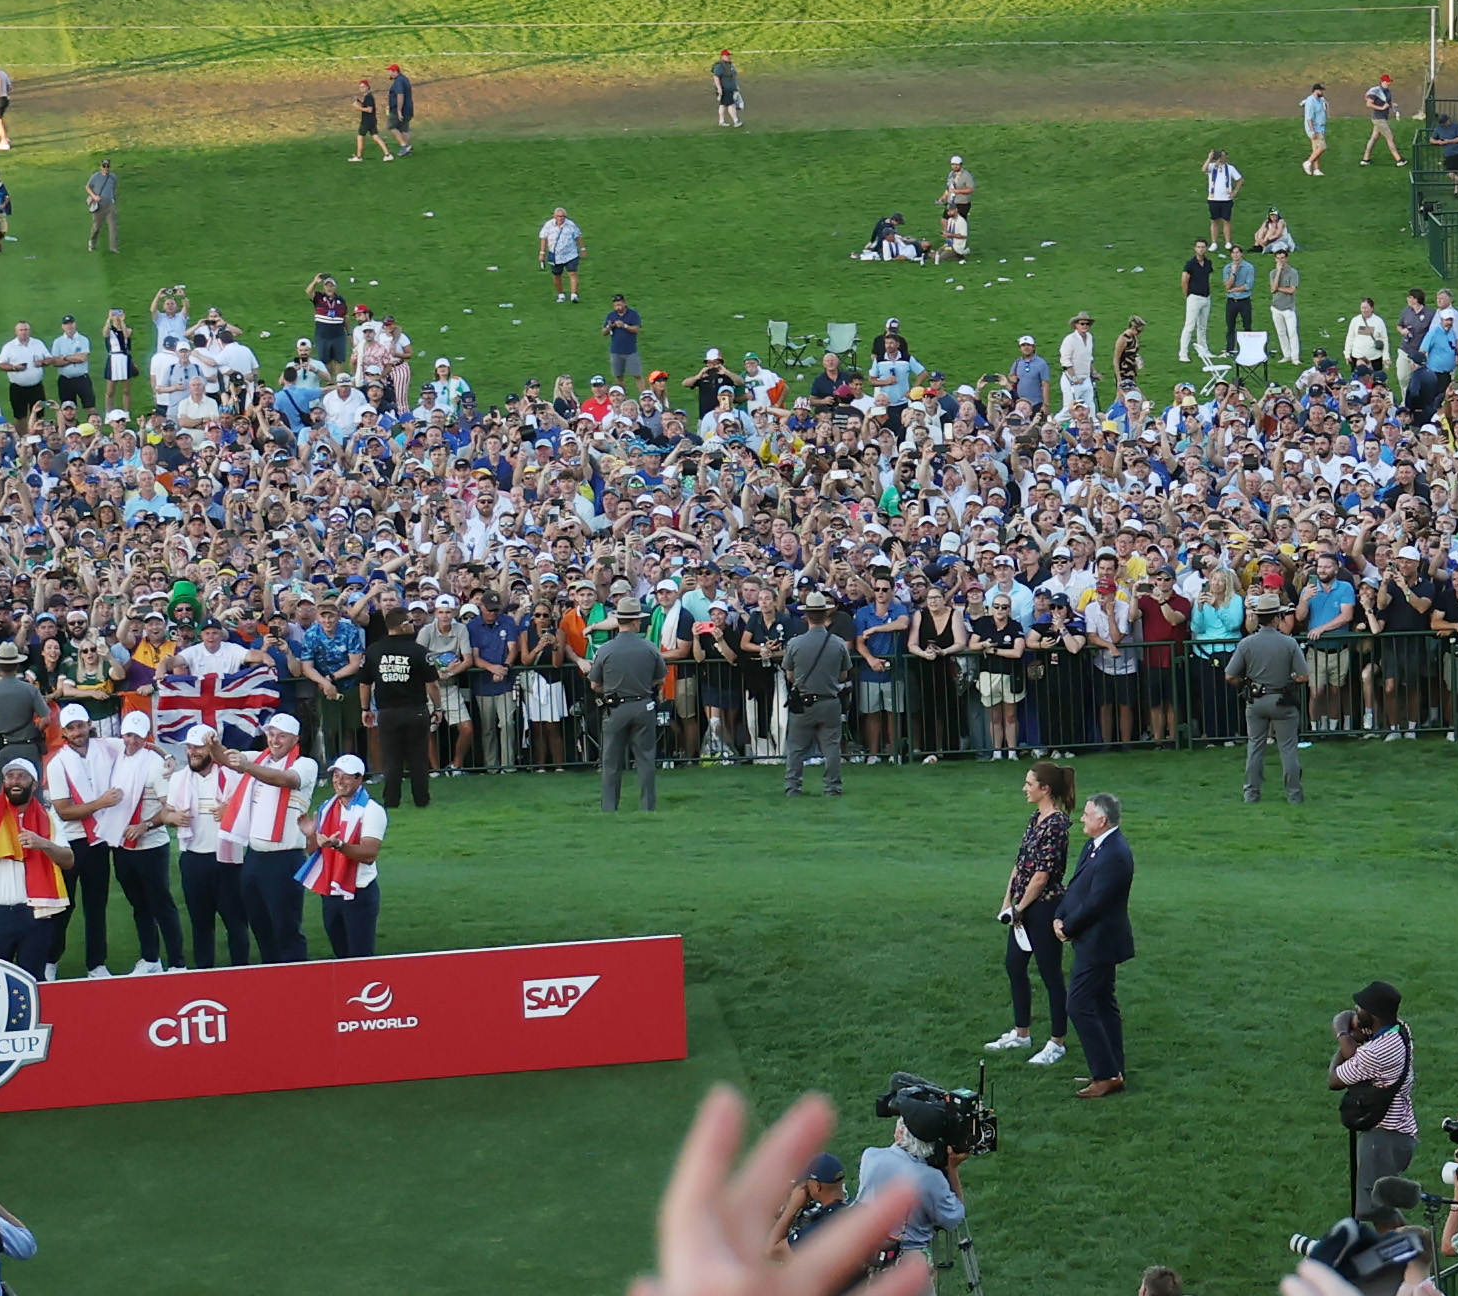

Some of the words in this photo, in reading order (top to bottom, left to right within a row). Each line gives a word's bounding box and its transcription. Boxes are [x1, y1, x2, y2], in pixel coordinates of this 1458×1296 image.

[380, 654, 410, 665] APEX
[378, 664, 411, 674] SECURITY
[381, 672, 410, 683] GROUP
[525, 985, 581, 1011] SAP
[148, 999, 229, 1048] citi
[337, 1020, 360, 1033] DP
[360, 1016, 419, 1031] WORLD
